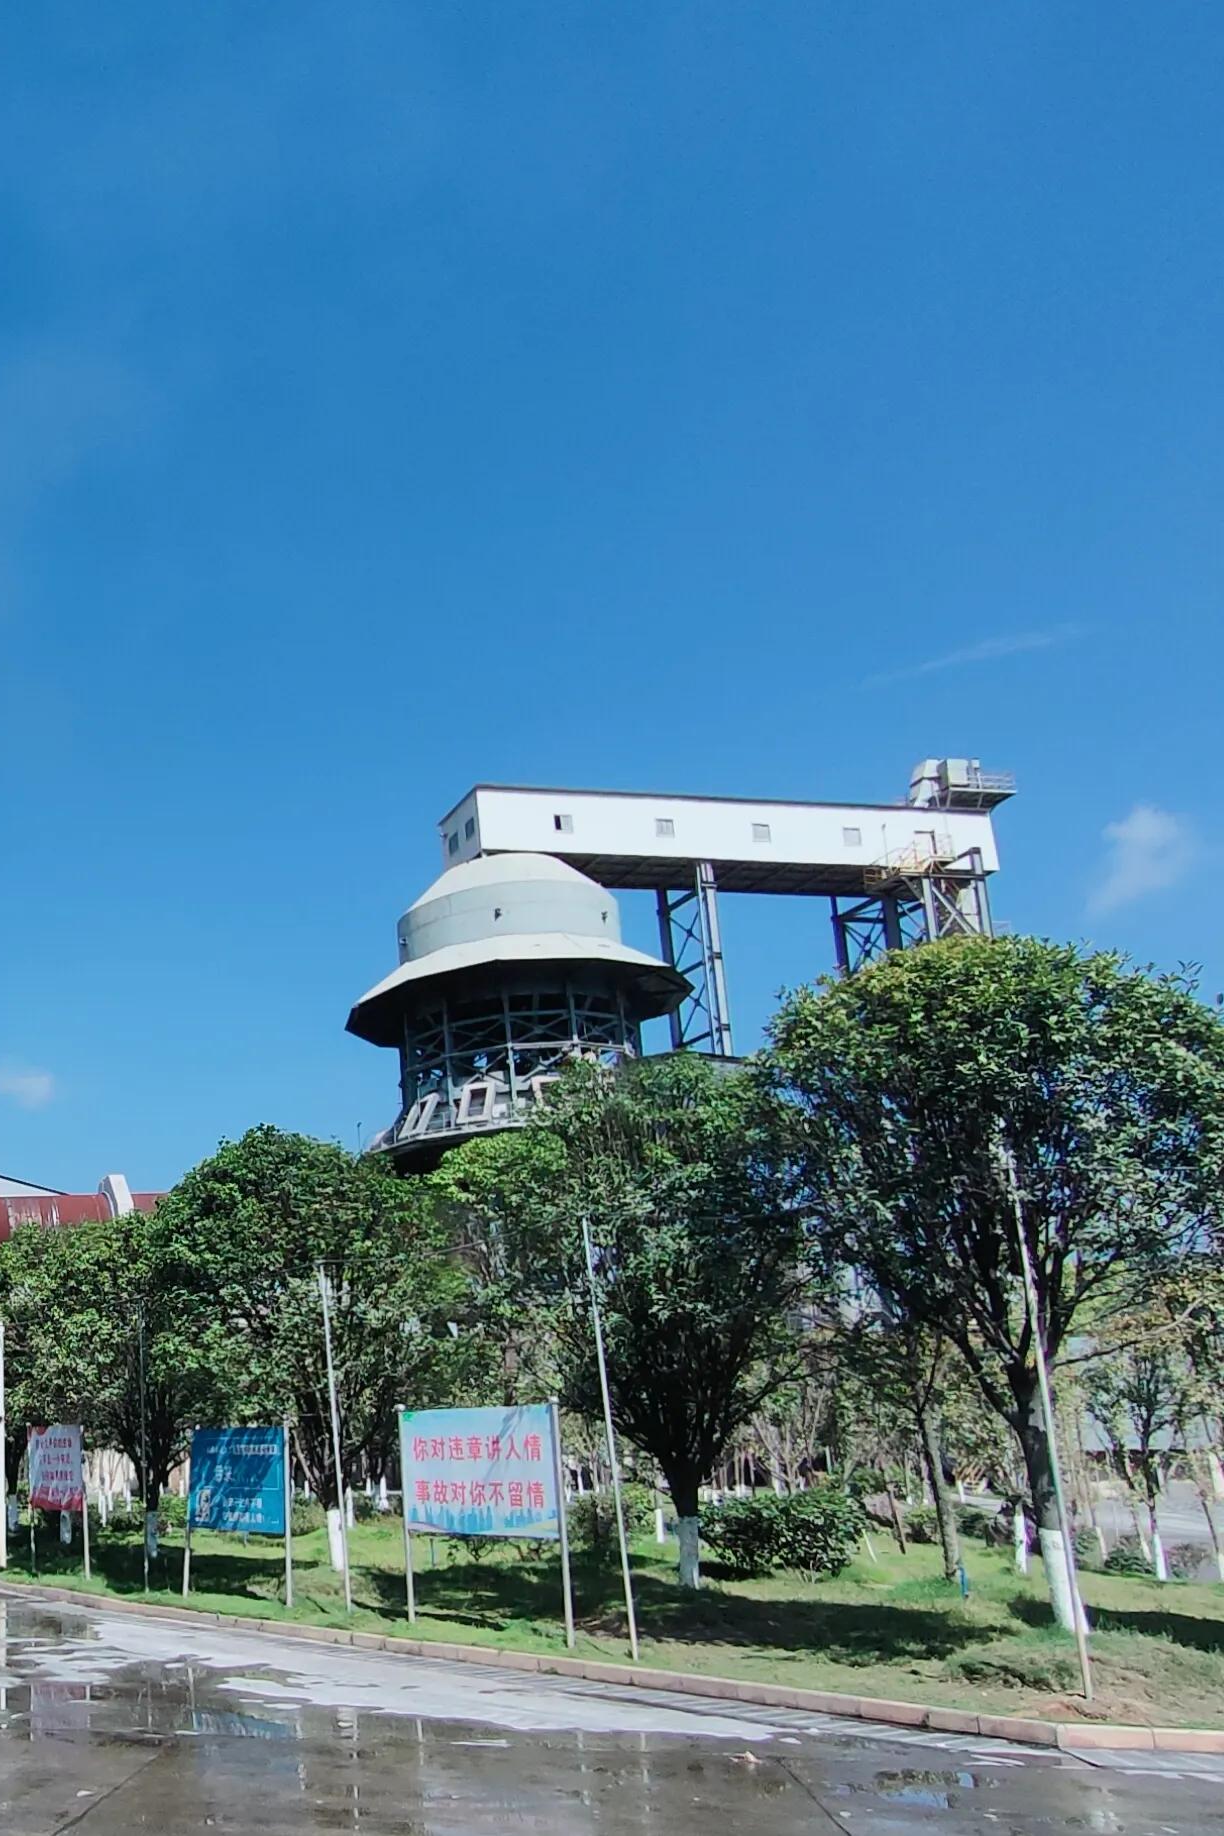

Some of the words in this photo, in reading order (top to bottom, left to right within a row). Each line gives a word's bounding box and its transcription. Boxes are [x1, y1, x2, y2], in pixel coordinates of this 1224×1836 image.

[413, 1434, 541, 1462] 你对违章讲人情
[415, 1480, 544, 1509] 事故对你不留情
